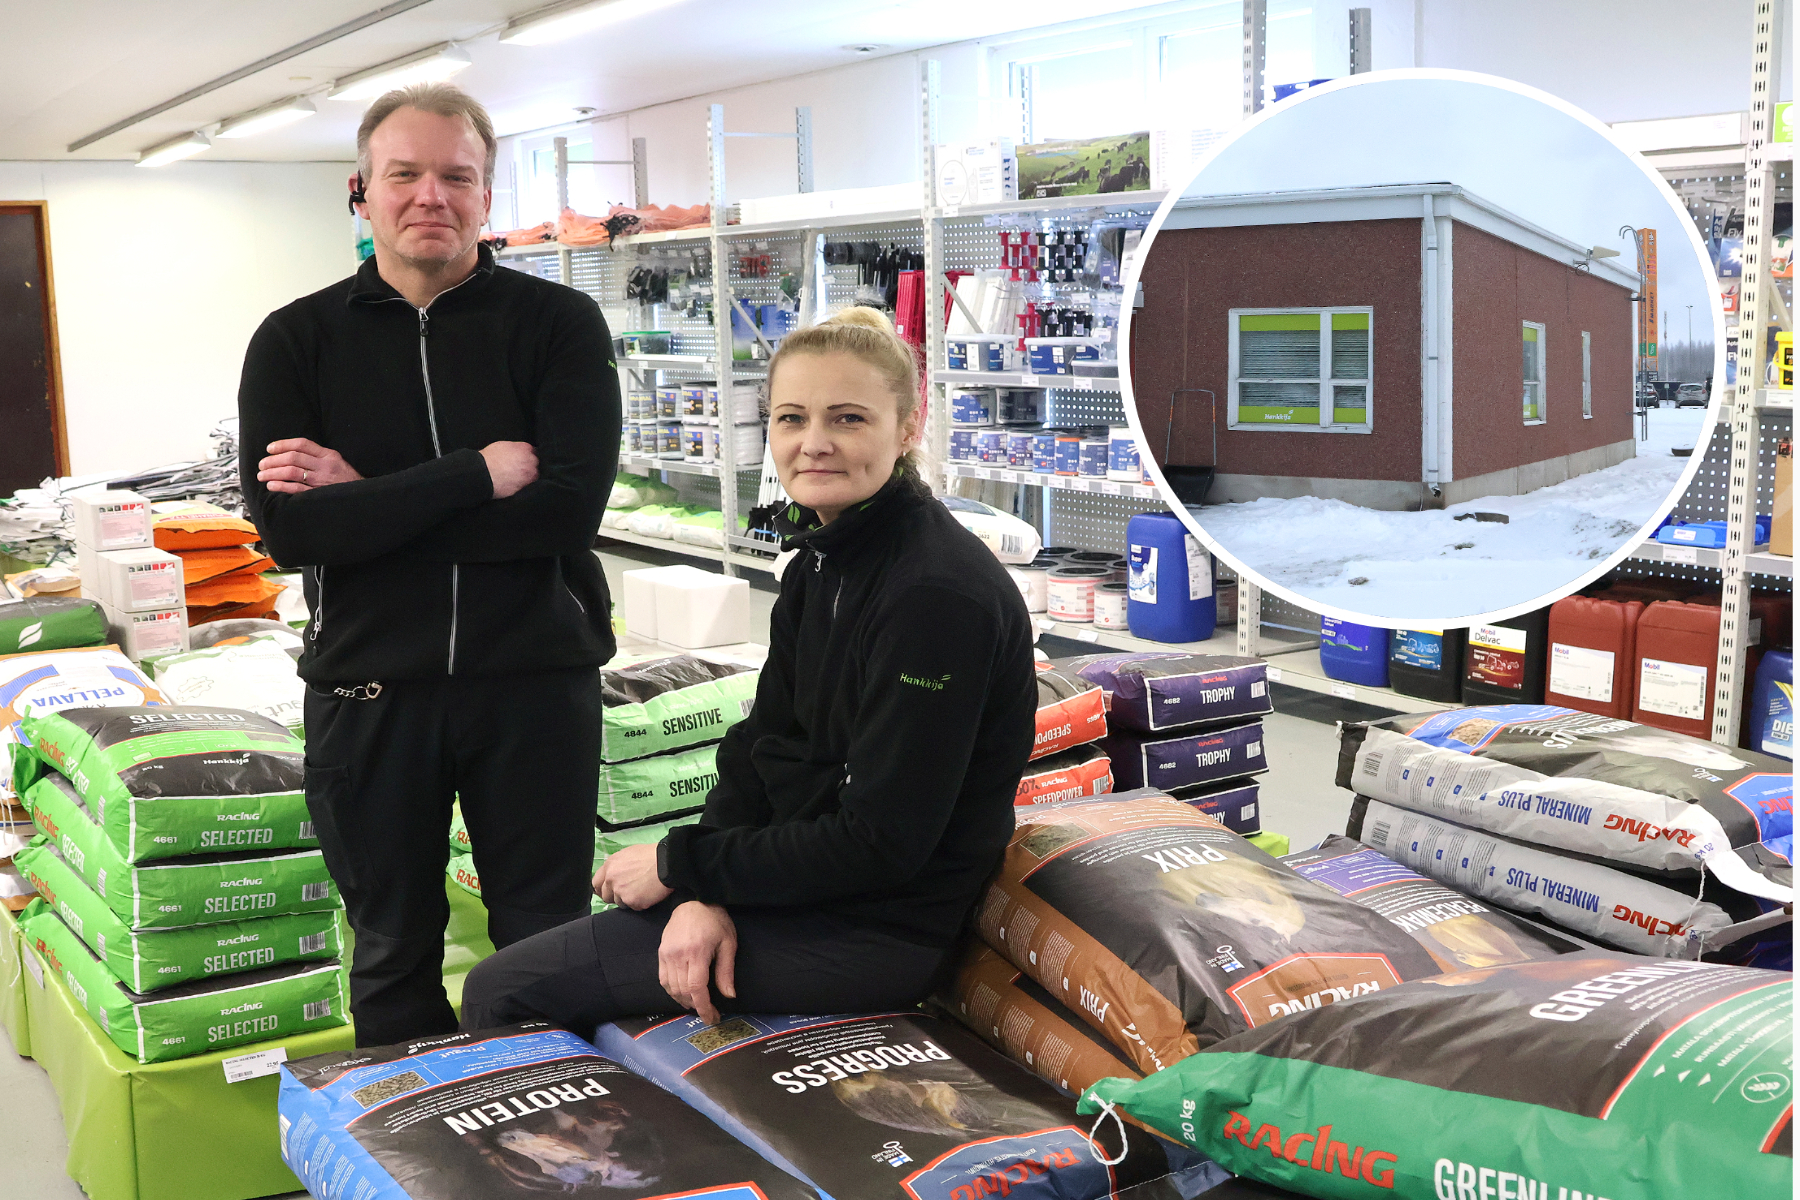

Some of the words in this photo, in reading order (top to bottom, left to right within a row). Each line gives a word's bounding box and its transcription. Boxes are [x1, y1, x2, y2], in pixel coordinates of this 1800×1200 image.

[1474, 633, 1501, 645] Delvac
[1480, 627, 1496, 636] Mobil
[1554, 646, 1570, 655] Mobil
[1644, 661, 1661, 670] Mobil
[900, 672, 944, 691] Hankkija
[31, 686, 125, 708] PELLAVA
[1200, 686, 1236, 705] TROPHY
[129, 713, 246, 725] SELECTED
[662, 707, 724, 736] SENSITIVE
[624, 728, 647, 738] 4844
[203, 757, 250, 766] Hankkija
[1196, 747, 1231, 768] TROPHY
[1041, 777, 1068, 788] RACING
[631, 790, 654, 800] 4844
[1032, 785, 1083, 805] SPEEDPOWER
[1498, 790, 1531, 812] PLUS
[216, 811, 260, 822] RACING
[1536, 794, 1593, 825] MINERAL
[153, 835, 178, 844] 4661
[200, 827, 273, 848] SELECTED
[1603, 813, 1696, 848] RACING
[1141, 843, 1229, 874] PRIX
[219, 877, 263, 888] RACING
[1506, 867, 1538, 893] PLUS
[204, 892, 277, 915] SELECTED
[1541, 878, 1600, 913] MINERAL
[158, 904, 182, 913] 4661
[1612, 904, 1693, 937] ACING
[216, 933, 260, 947] RACING
[157, 965, 182, 975] 4661
[203, 946, 275, 974] SELECTED
[220, 1001, 264, 1017] RACING
[1080, 984, 1110, 1024] PRIX
[207, 1014, 279, 1044] SELECTED
[162, 1036, 186, 1046] 4661
[771, 1040, 952, 1094] PROGRESS
[442, 1078, 611, 1136] PROTEIN
[1183, 1099, 1196, 1122] kg
[1183, 1121, 1196, 1142] 20
[1222, 1110, 1399, 1190] RACING
[949, 1147, 1081, 1200] RACING
